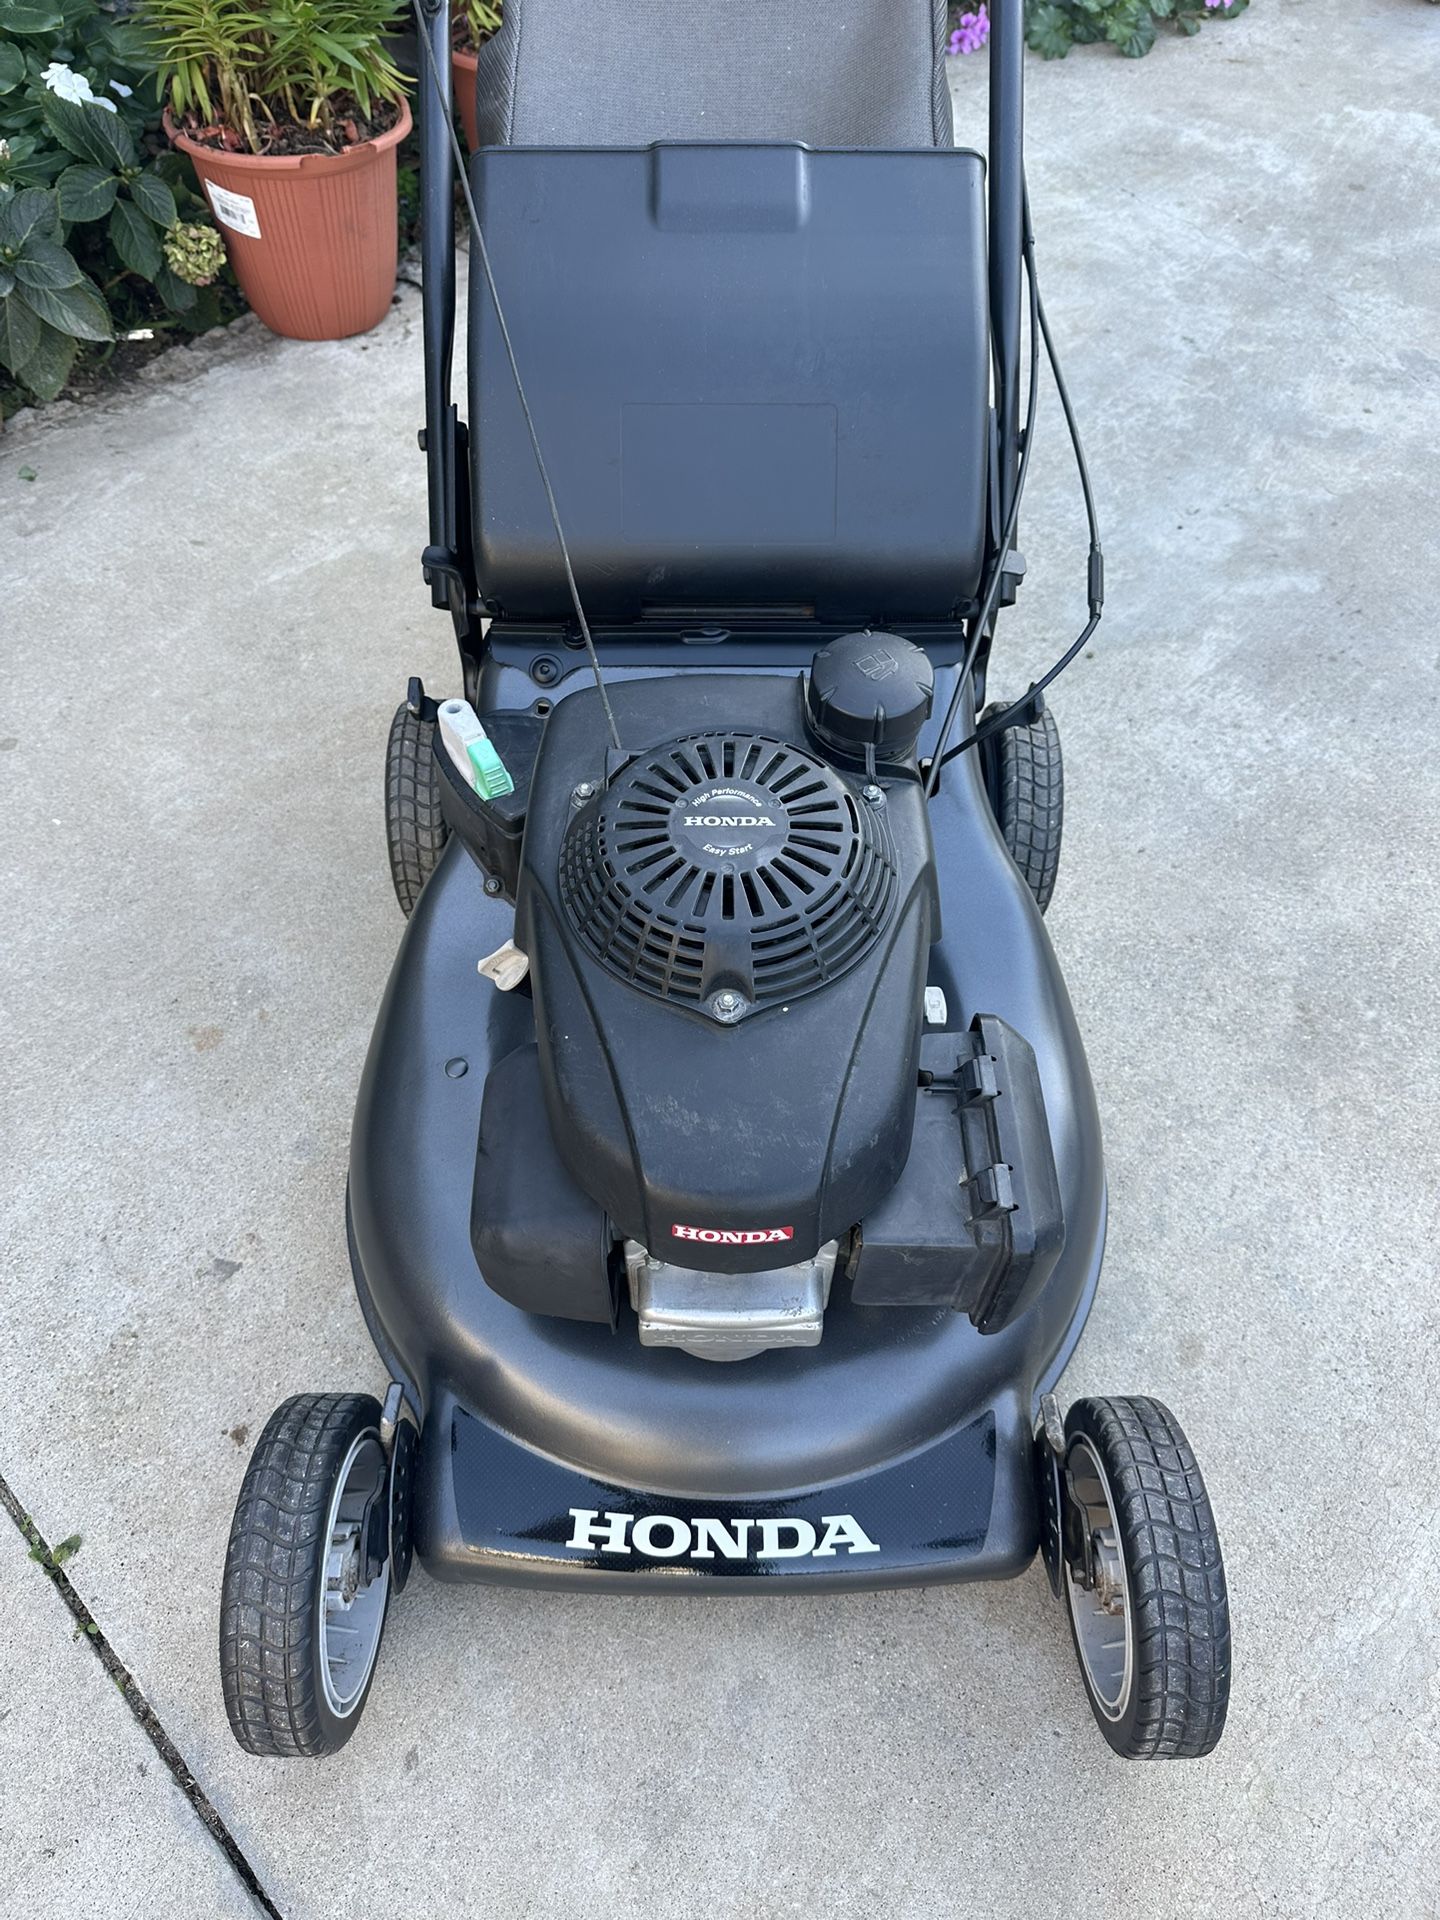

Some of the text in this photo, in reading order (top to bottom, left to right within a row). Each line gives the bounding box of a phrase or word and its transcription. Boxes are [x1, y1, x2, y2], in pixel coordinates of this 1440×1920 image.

[692, 788, 762, 807] High Performance
[684, 816, 776, 827] HONDA
[702, 843, 753, 856] Easy Start
[673, 1225, 791, 1243] HONDA
[565, 1508, 881, 1559] HONDA
